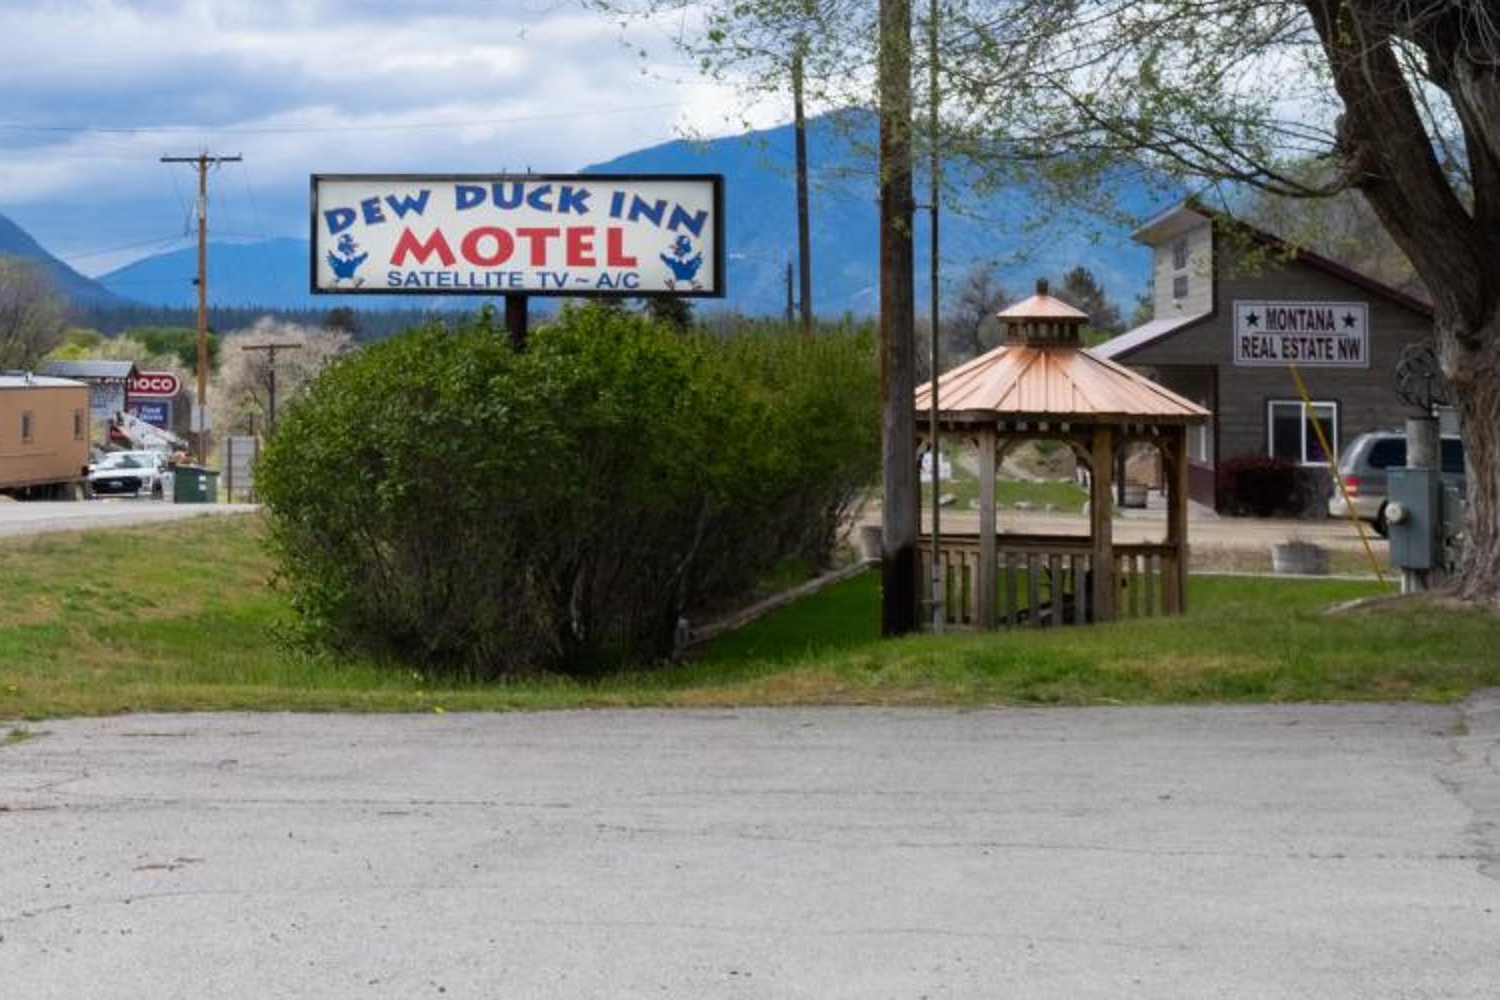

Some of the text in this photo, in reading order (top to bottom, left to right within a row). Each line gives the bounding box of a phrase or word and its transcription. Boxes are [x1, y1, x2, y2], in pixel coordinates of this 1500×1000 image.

[324, 183, 709, 238] DEW DUCK INN
[389, 226, 638, 268] MOTEL
[387, 270, 523, 289] SATELLITE
[535, 270, 569, 289] TV
[595, 270, 640, 289] A/C
[1265, 307, 1336, 332] MONTANA
[1241, 335, 1361, 361] REAL ESTATE NW
